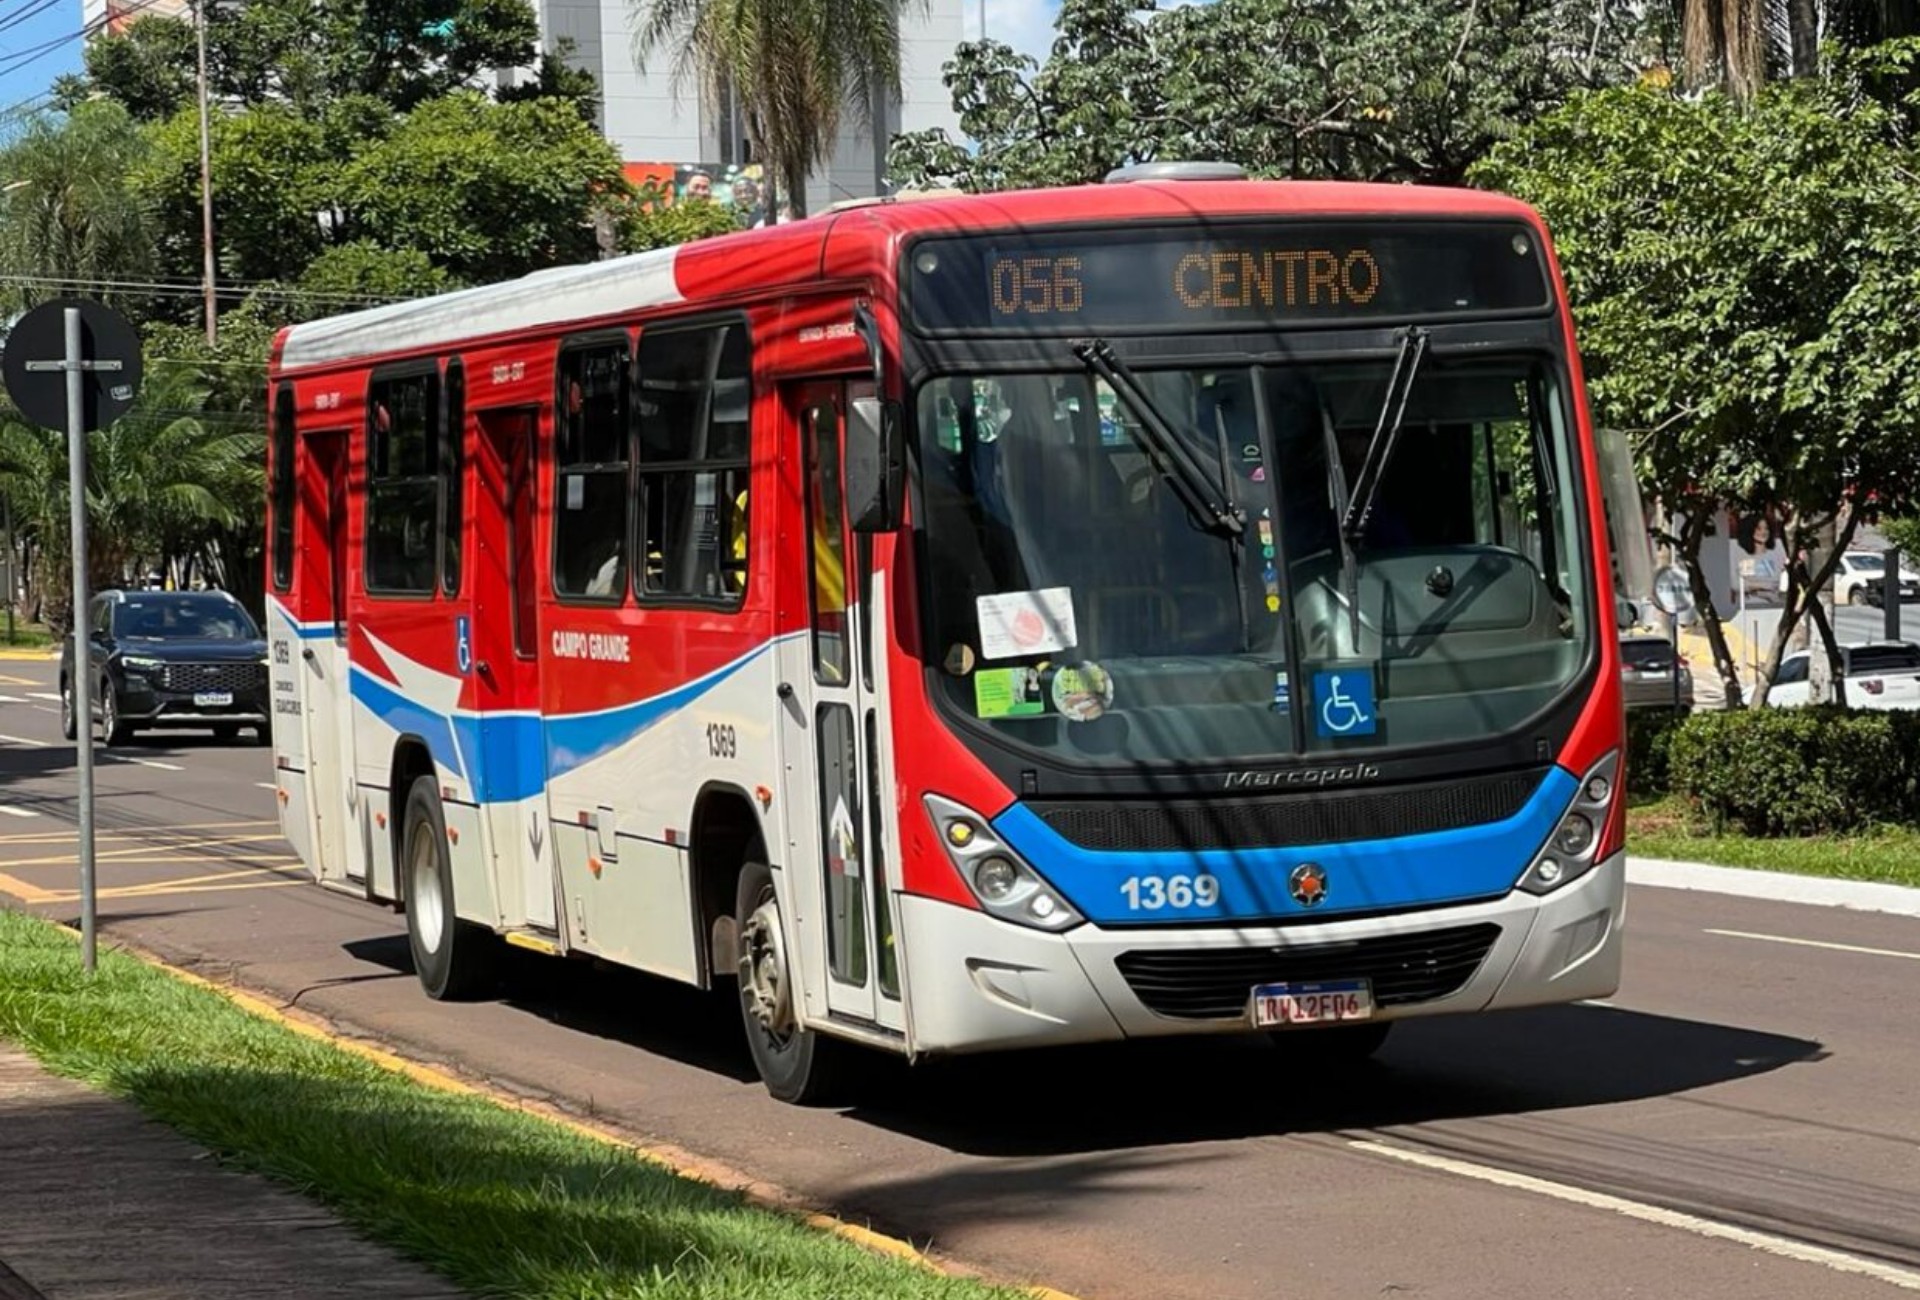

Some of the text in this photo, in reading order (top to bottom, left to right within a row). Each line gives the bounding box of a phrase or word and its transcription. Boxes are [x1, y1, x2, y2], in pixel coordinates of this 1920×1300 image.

[992, 249, 1380, 314] 056 CENTRO
[552, 630, 631, 663] CAMPO GRANDE
[706, 722, 736, 759] 1369
[1223, 763, 1379, 788] Marcopolo
[1120, 874, 1219, 910] 1369
